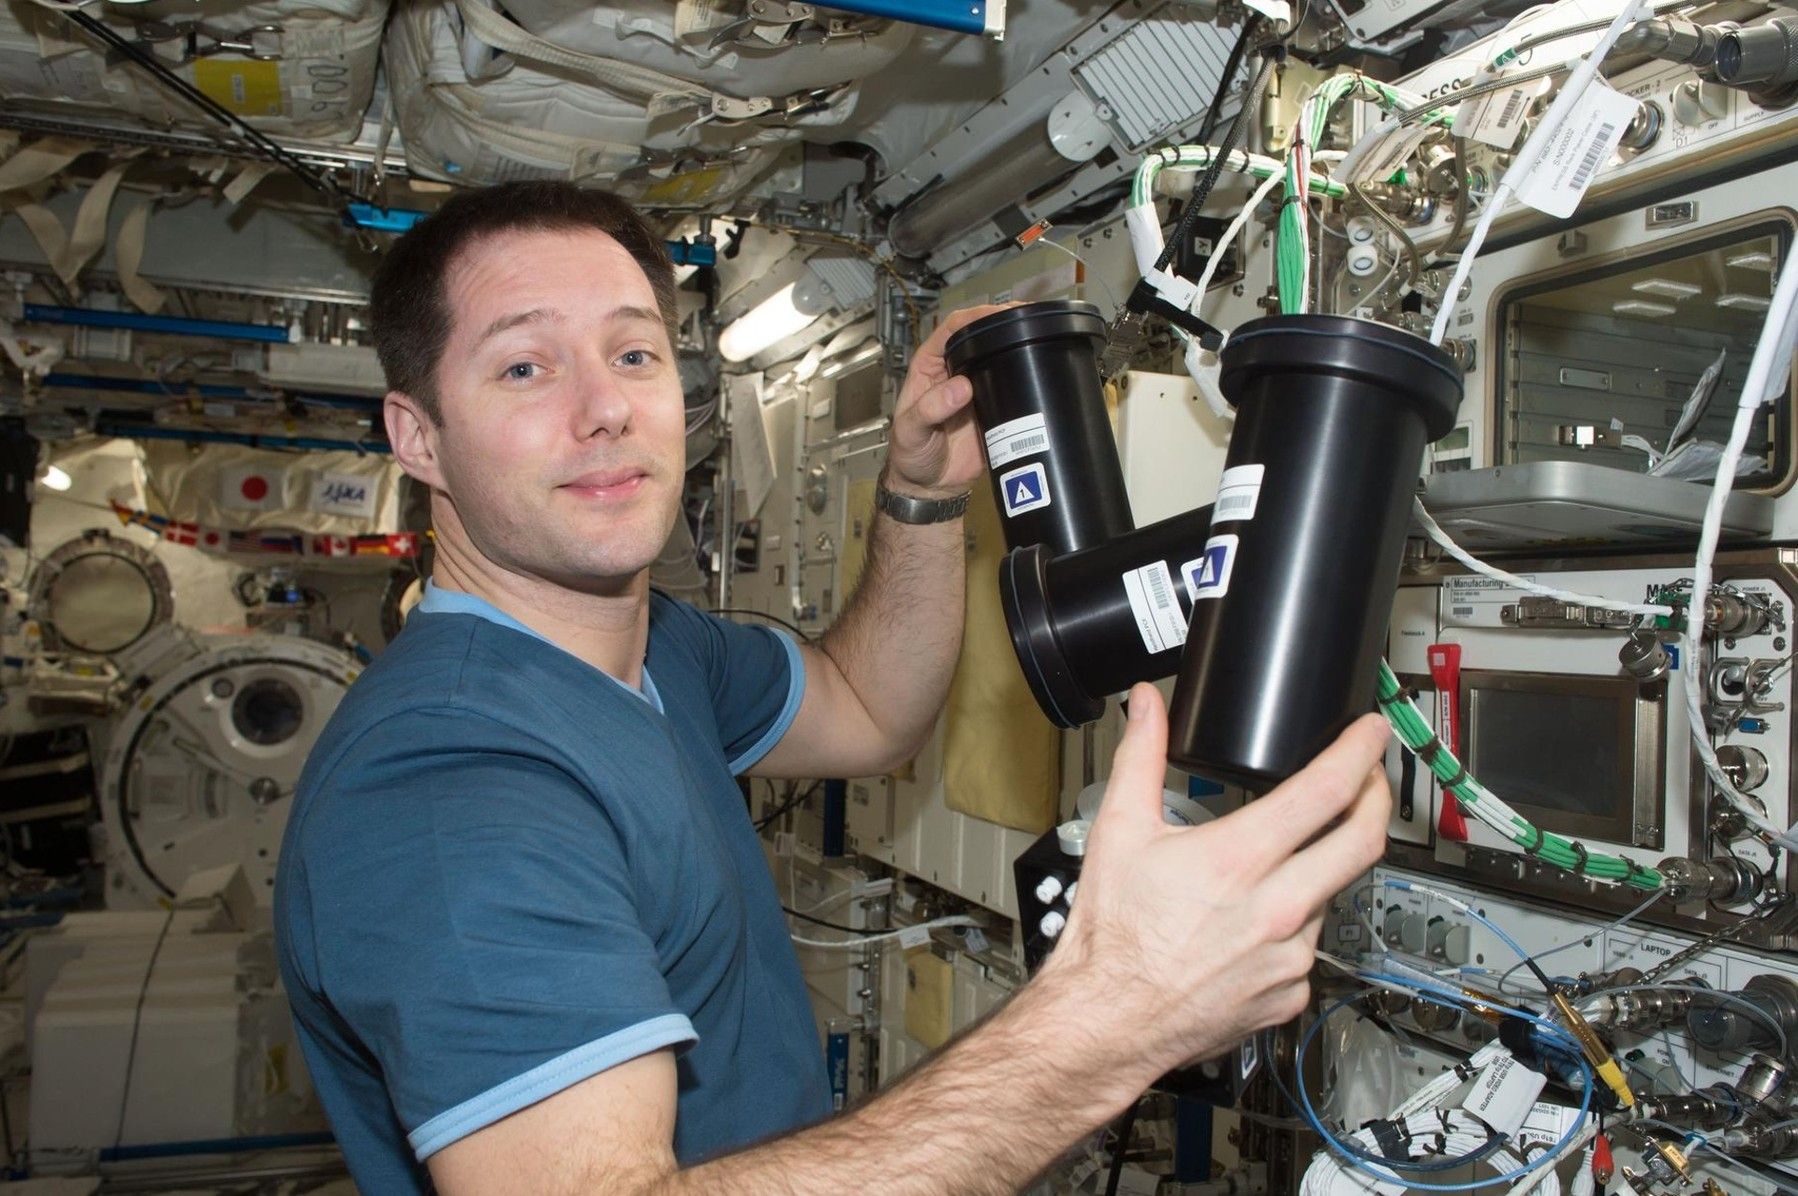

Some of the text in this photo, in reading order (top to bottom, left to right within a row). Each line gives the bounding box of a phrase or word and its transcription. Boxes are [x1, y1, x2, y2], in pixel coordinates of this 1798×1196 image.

[1453, 579, 1503, 590] Manufacturing
[1640, 943, 1671, 956] LAPTOP
[1485, 1071, 1499, 1089] LAPTOP
[1499, 1069, 1509, 1080] USB
[1491, 1078, 1503, 1093] VIDEO
[1479, 1091, 1495, 1112] ADAPTER
